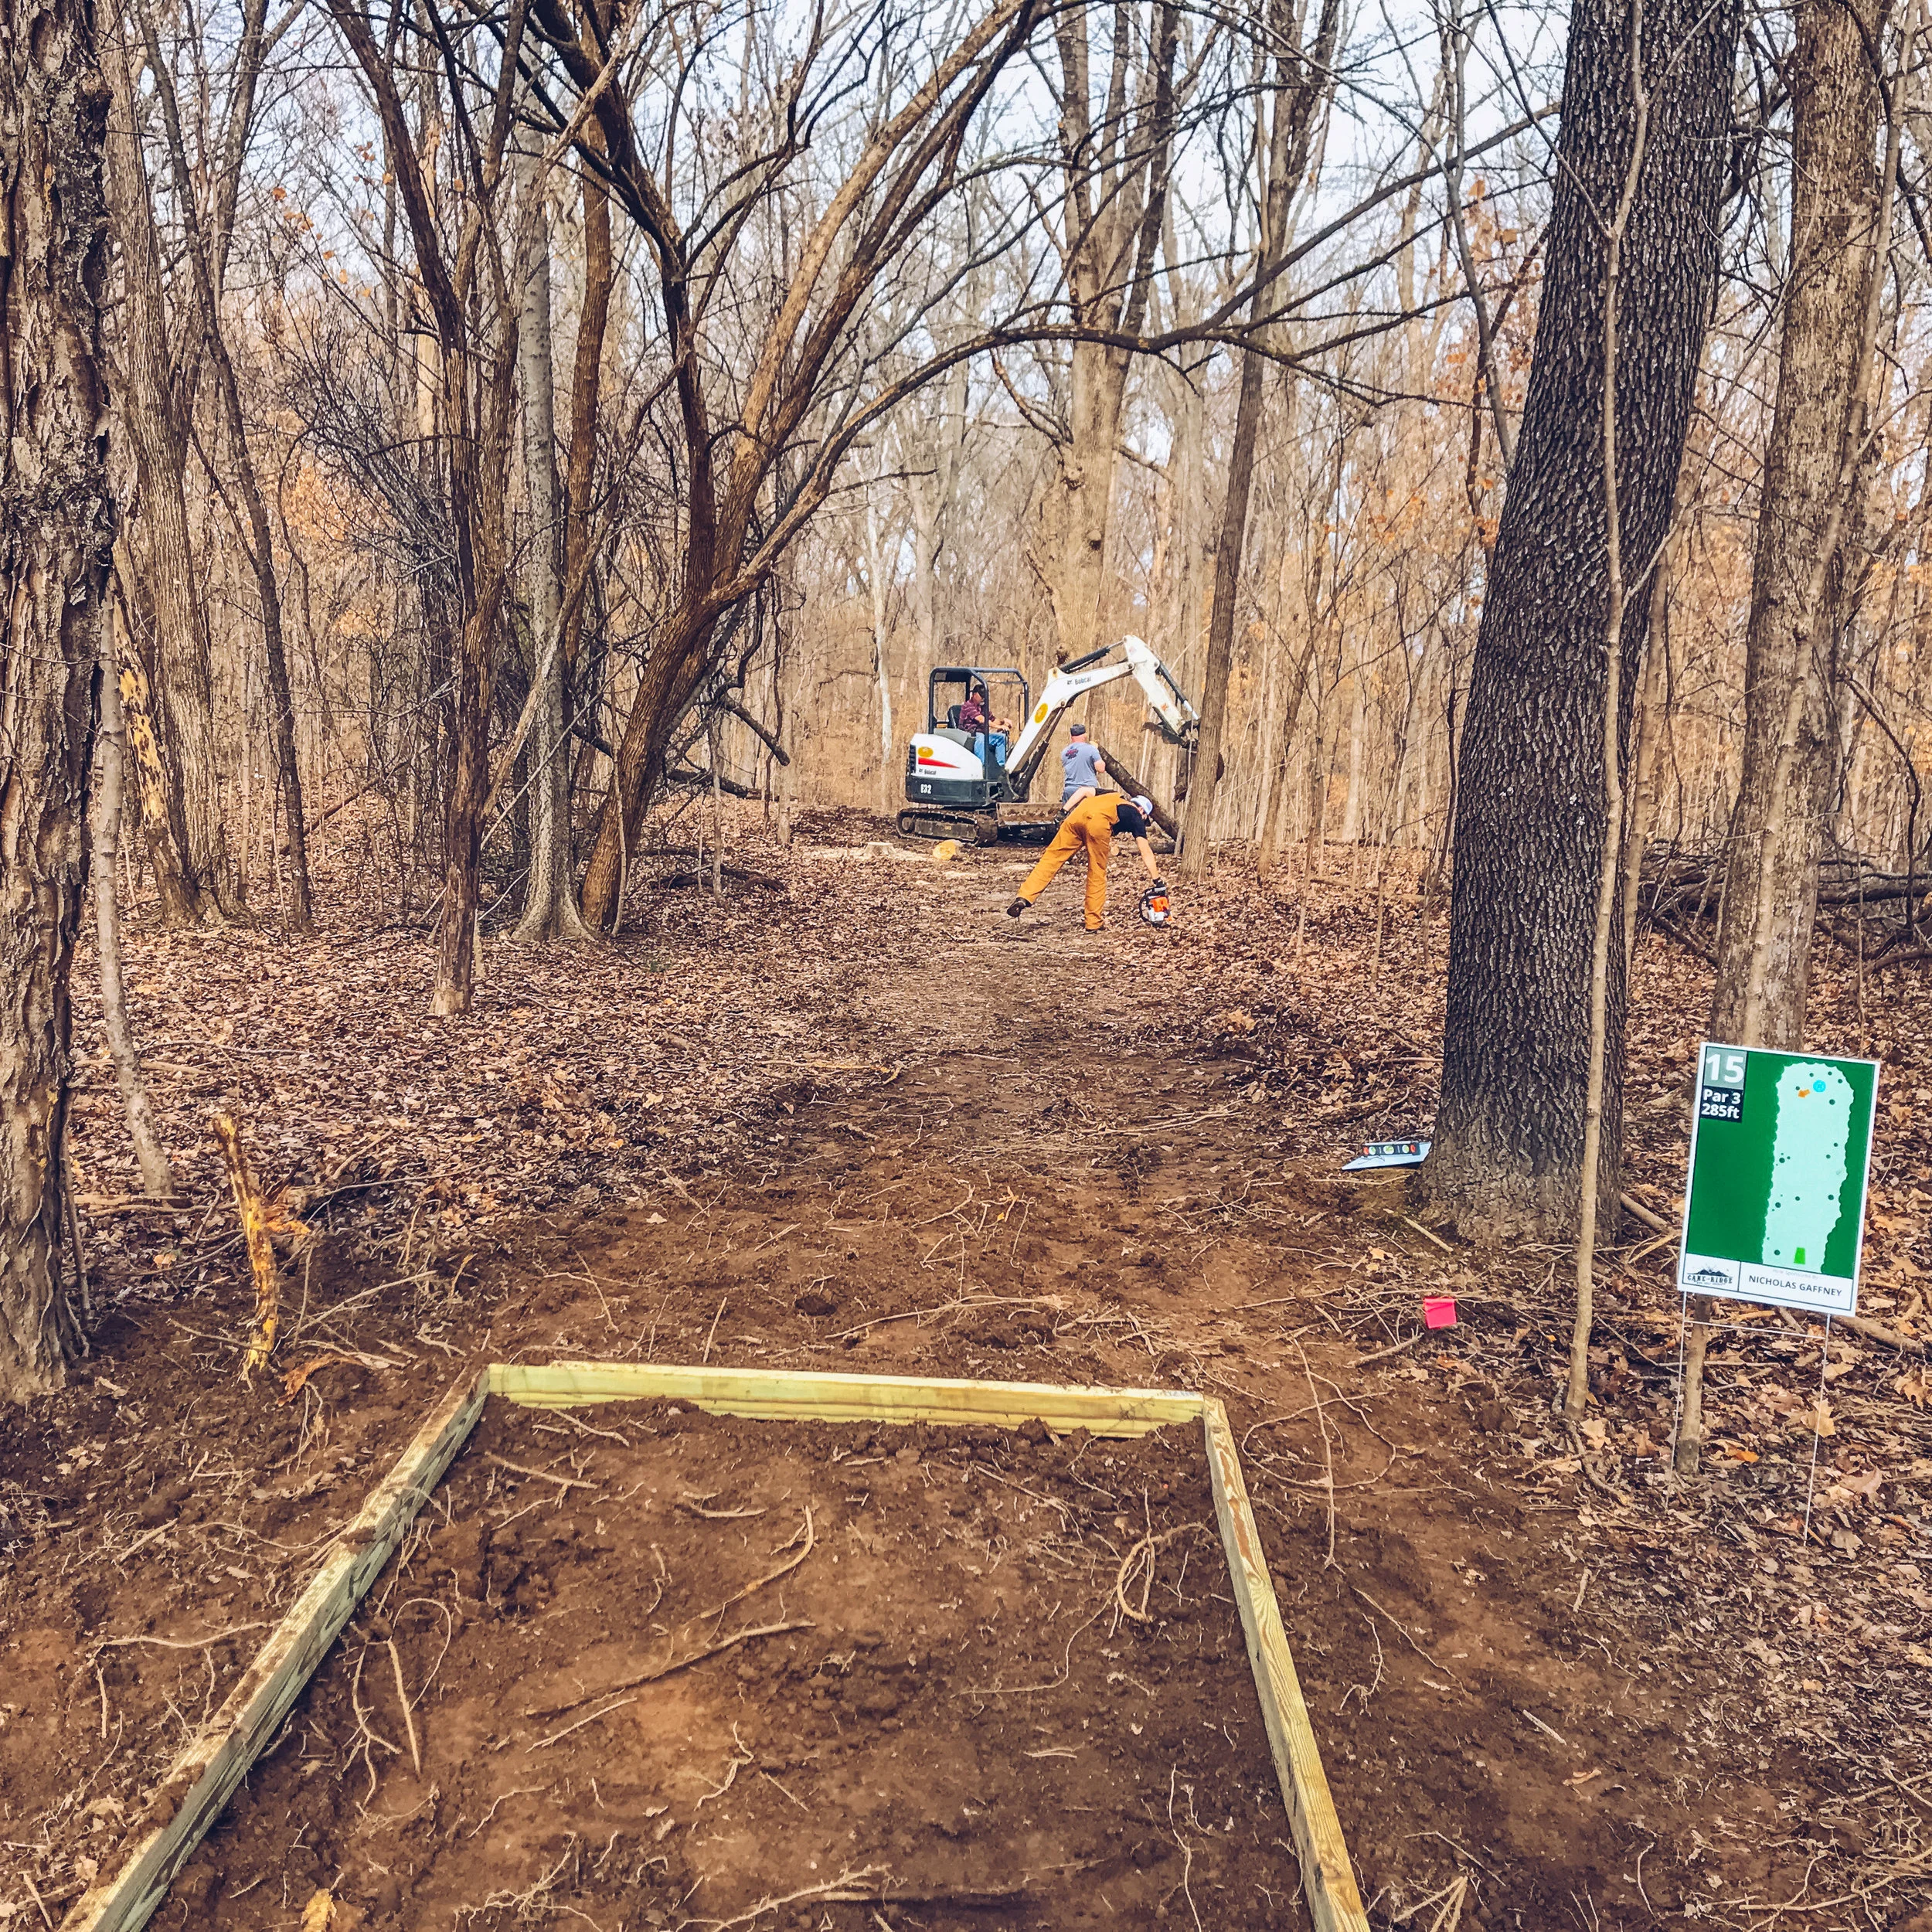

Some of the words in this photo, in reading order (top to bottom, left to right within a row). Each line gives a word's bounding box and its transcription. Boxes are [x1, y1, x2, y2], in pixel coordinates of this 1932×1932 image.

[920, 784, 932, 794] E32
[1706, 1053, 1744, 1083] 15
[1703, 1088, 1729, 1103] Par
[1731, 1092, 1741, 1104] 3
[1701, 1102, 1740, 1119] 285ft
[1749, 1275, 1796, 1289] NICHOLAS
[1799, 1284, 1842, 1296] GAFFNEY
